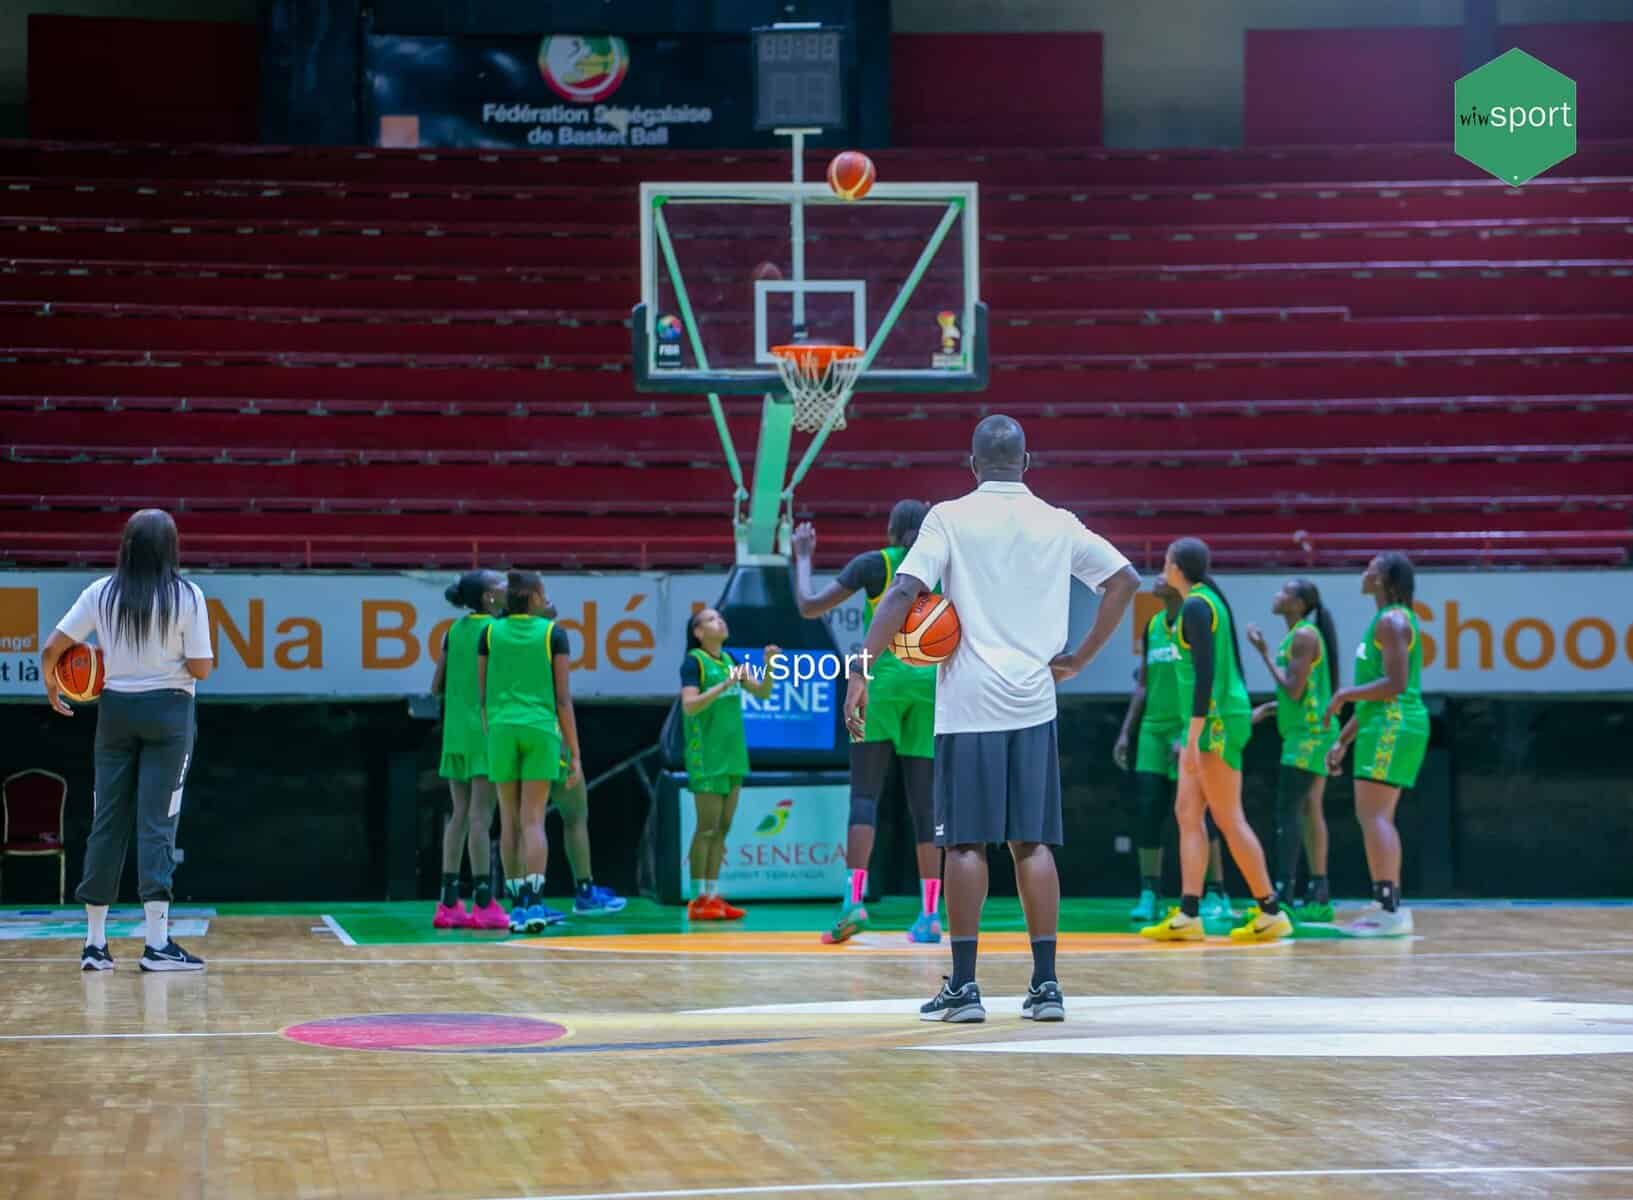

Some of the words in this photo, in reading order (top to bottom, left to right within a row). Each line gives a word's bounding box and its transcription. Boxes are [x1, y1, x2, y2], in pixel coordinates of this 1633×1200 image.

[482, 103, 589, 123] Fédération
[593, 103, 713, 127] Snégalaise
[527, 126, 553, 145] de
[558, 126, 627, 145] Basket
[631, 126, 668, 145] Ball
[0, 636, 32, 653] nge
[206, 598, 324, 672] Na
[1412, 600, 1633, 672] hoo
[19, 658, 39, 682] là
[739, 842, 849, 866] SENEGA
